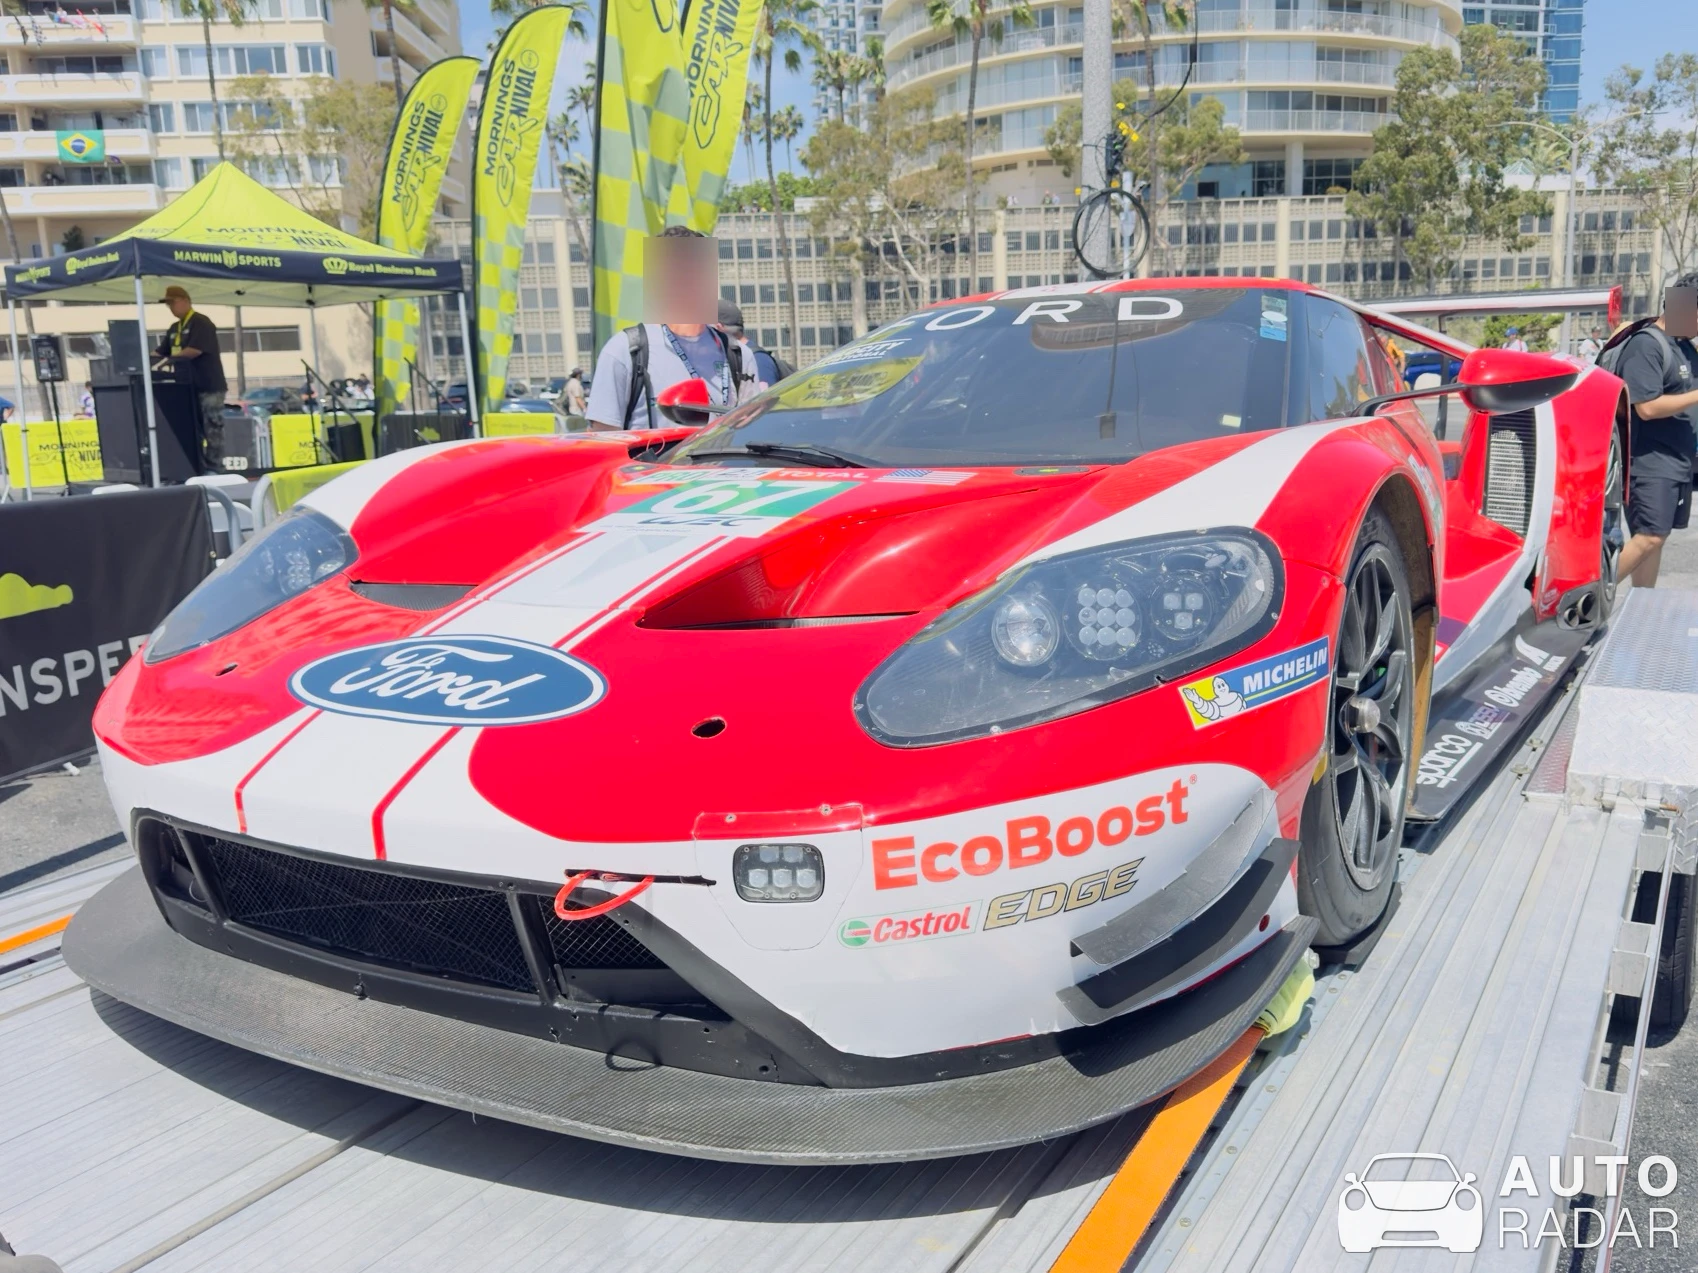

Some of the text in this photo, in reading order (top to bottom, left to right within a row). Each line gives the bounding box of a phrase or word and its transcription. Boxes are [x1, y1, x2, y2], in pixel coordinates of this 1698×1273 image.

[485, 58, 515, 176] MORNINGS
[392, 101, 425, 203] MORNINGS
[174, 250, 282, 268] MARWIN SPORTS
[348, 261, 437, 277] Royal Business Bank
[866, 297, 1184, 339] FORD
[222, 456, 249, 471] EED
[778, 470, 870, 479] TOTAL
[651, 480, 842, 515] 67
[637, 515, 765, 527] WEC
[0, 633, 150, 718] NSPE
[330, 645, 547, 711] Ford
[1243, 646, 1328, 695] MICHELIN
[1493, 667, 1543, 701] brembo
[1416, 734, 1472, 785] sparco
[871, 778, 1189, 891] EcoBoost
[873, 857, 1145, 943] Castrol EDGE
